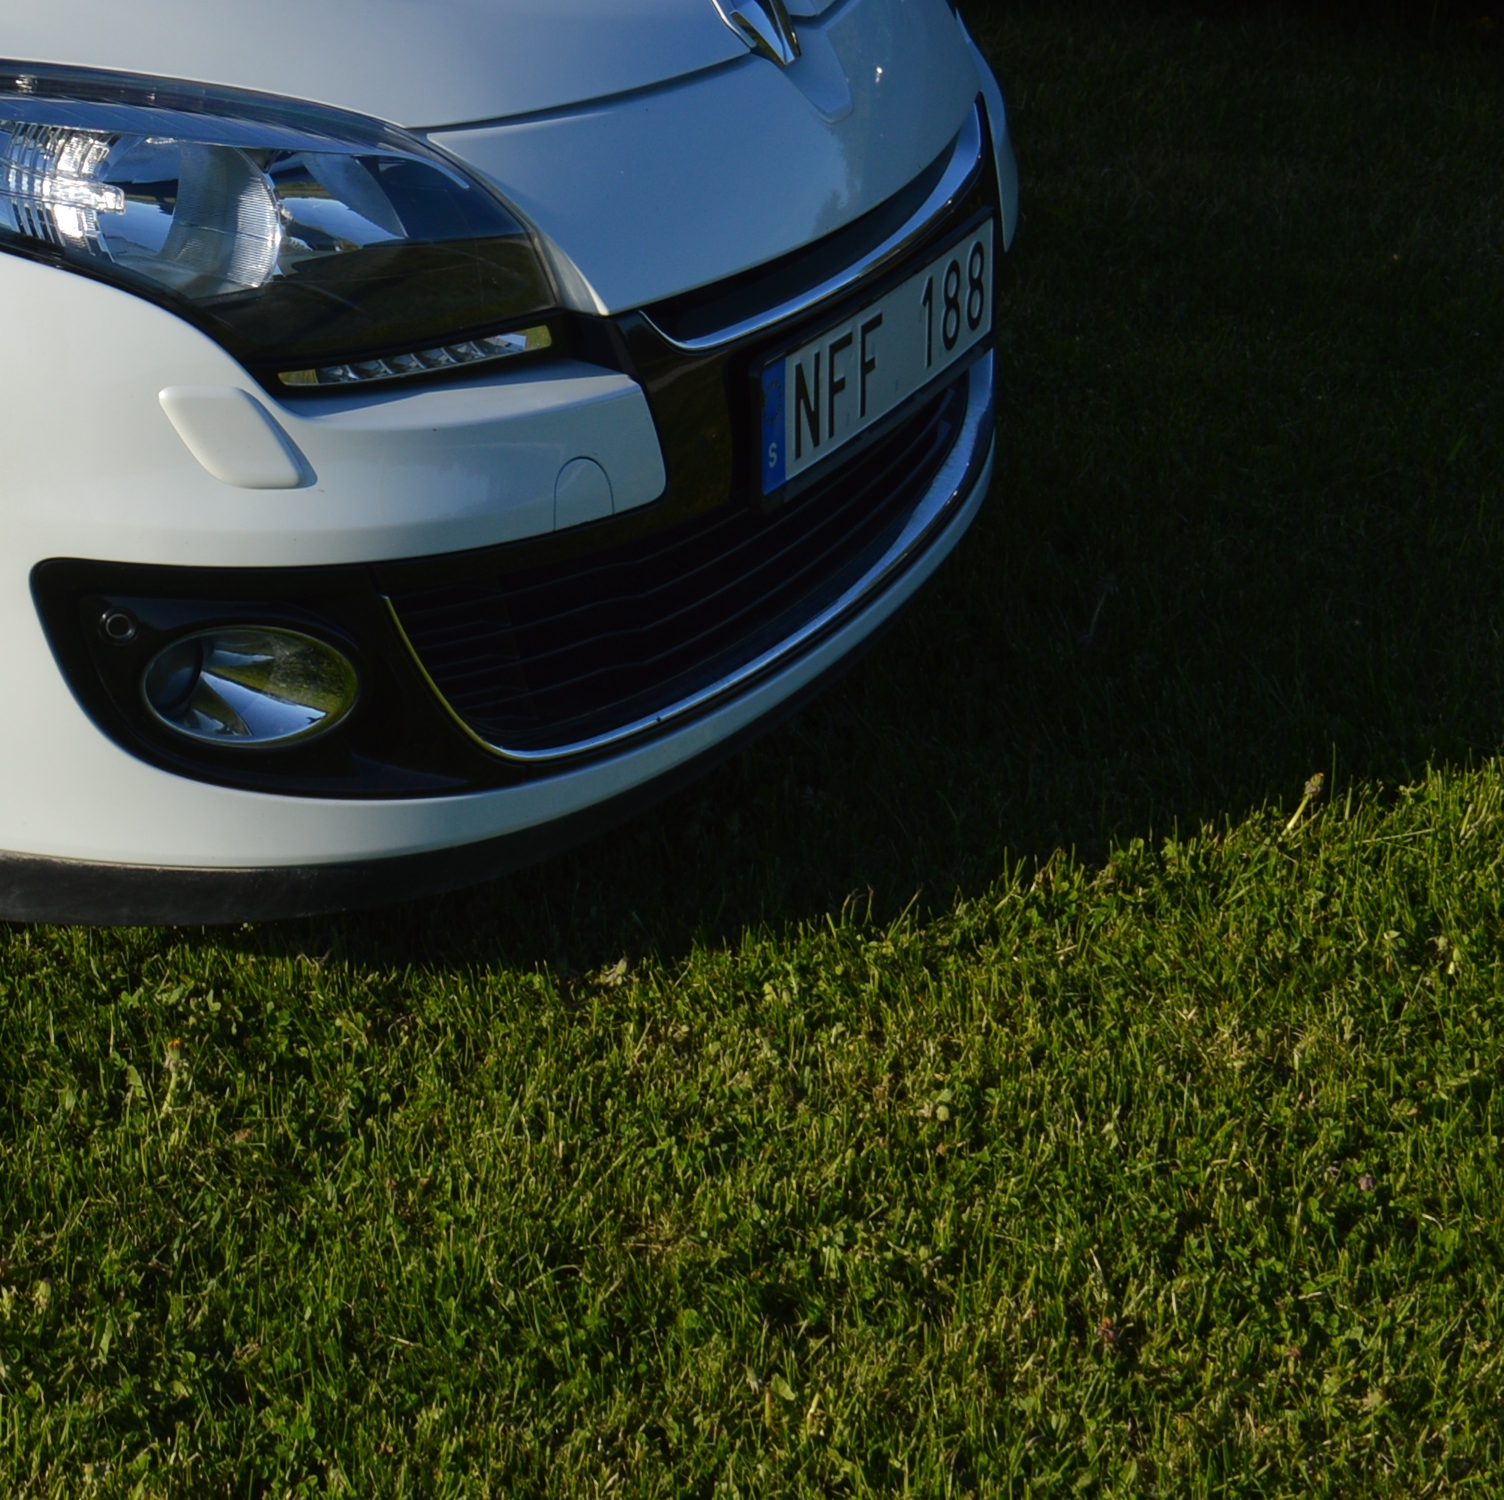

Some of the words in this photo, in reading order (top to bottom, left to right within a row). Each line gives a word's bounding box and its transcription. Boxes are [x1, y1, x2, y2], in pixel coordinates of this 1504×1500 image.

[794, 311, 883, 461] NFF
[921, 240, 985, 369] 188
[767, 442, 778, 468] S
